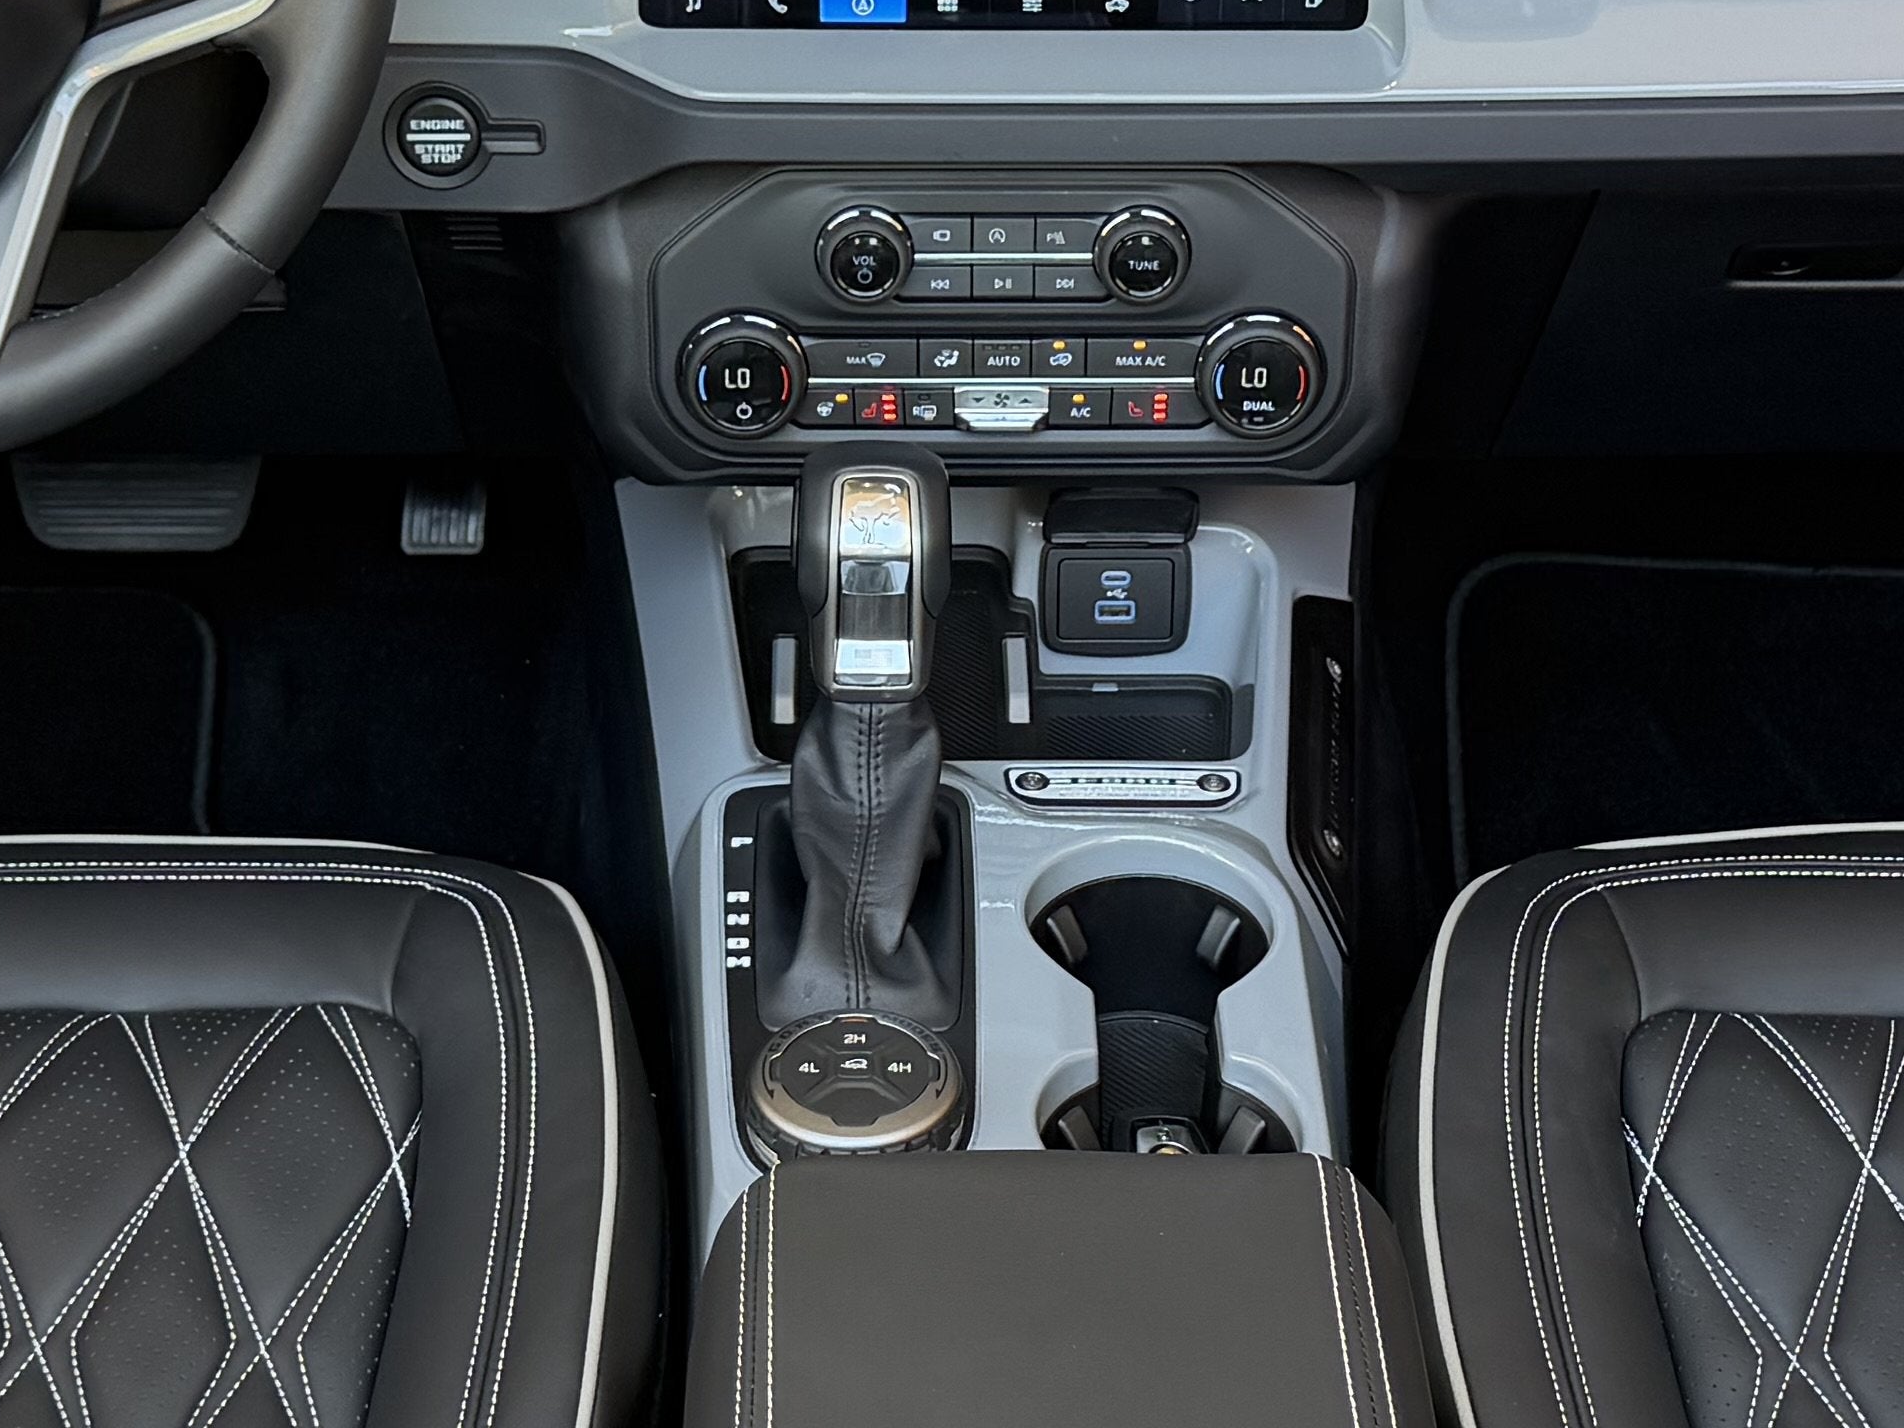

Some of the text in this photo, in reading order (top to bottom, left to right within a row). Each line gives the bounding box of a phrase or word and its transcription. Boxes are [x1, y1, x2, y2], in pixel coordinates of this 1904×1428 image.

[410, 119, 465, 130] ENGINE
[414, 144, 465, 154] START
[421, 154, 462, 164] STOP
[852, 255, 876, 267] VOL
[1128, 260, 1160, 271] TUNE
[987, 355, 1021, 367] AUTO
[1115, 355, 1166, 367] MAX A/C
[724, 367, 751, 389] LO
[1241, 367, 1267, 389] LO
[1070, 406, 1092, 418] A/C
[1243, 400, 1276, 412] DUAL
[731, 836, 754, 848] P
[726, 891, 750, 903] R
[726, 913, 750, 925] N
[726, 937, 749, 949] D
[726, 956, 751, 968] M
[843, 1033, 866, 1044] 2H
[798, 1063, 820, 1073] 4L
[887, 1063, 912, 1073] 4H
